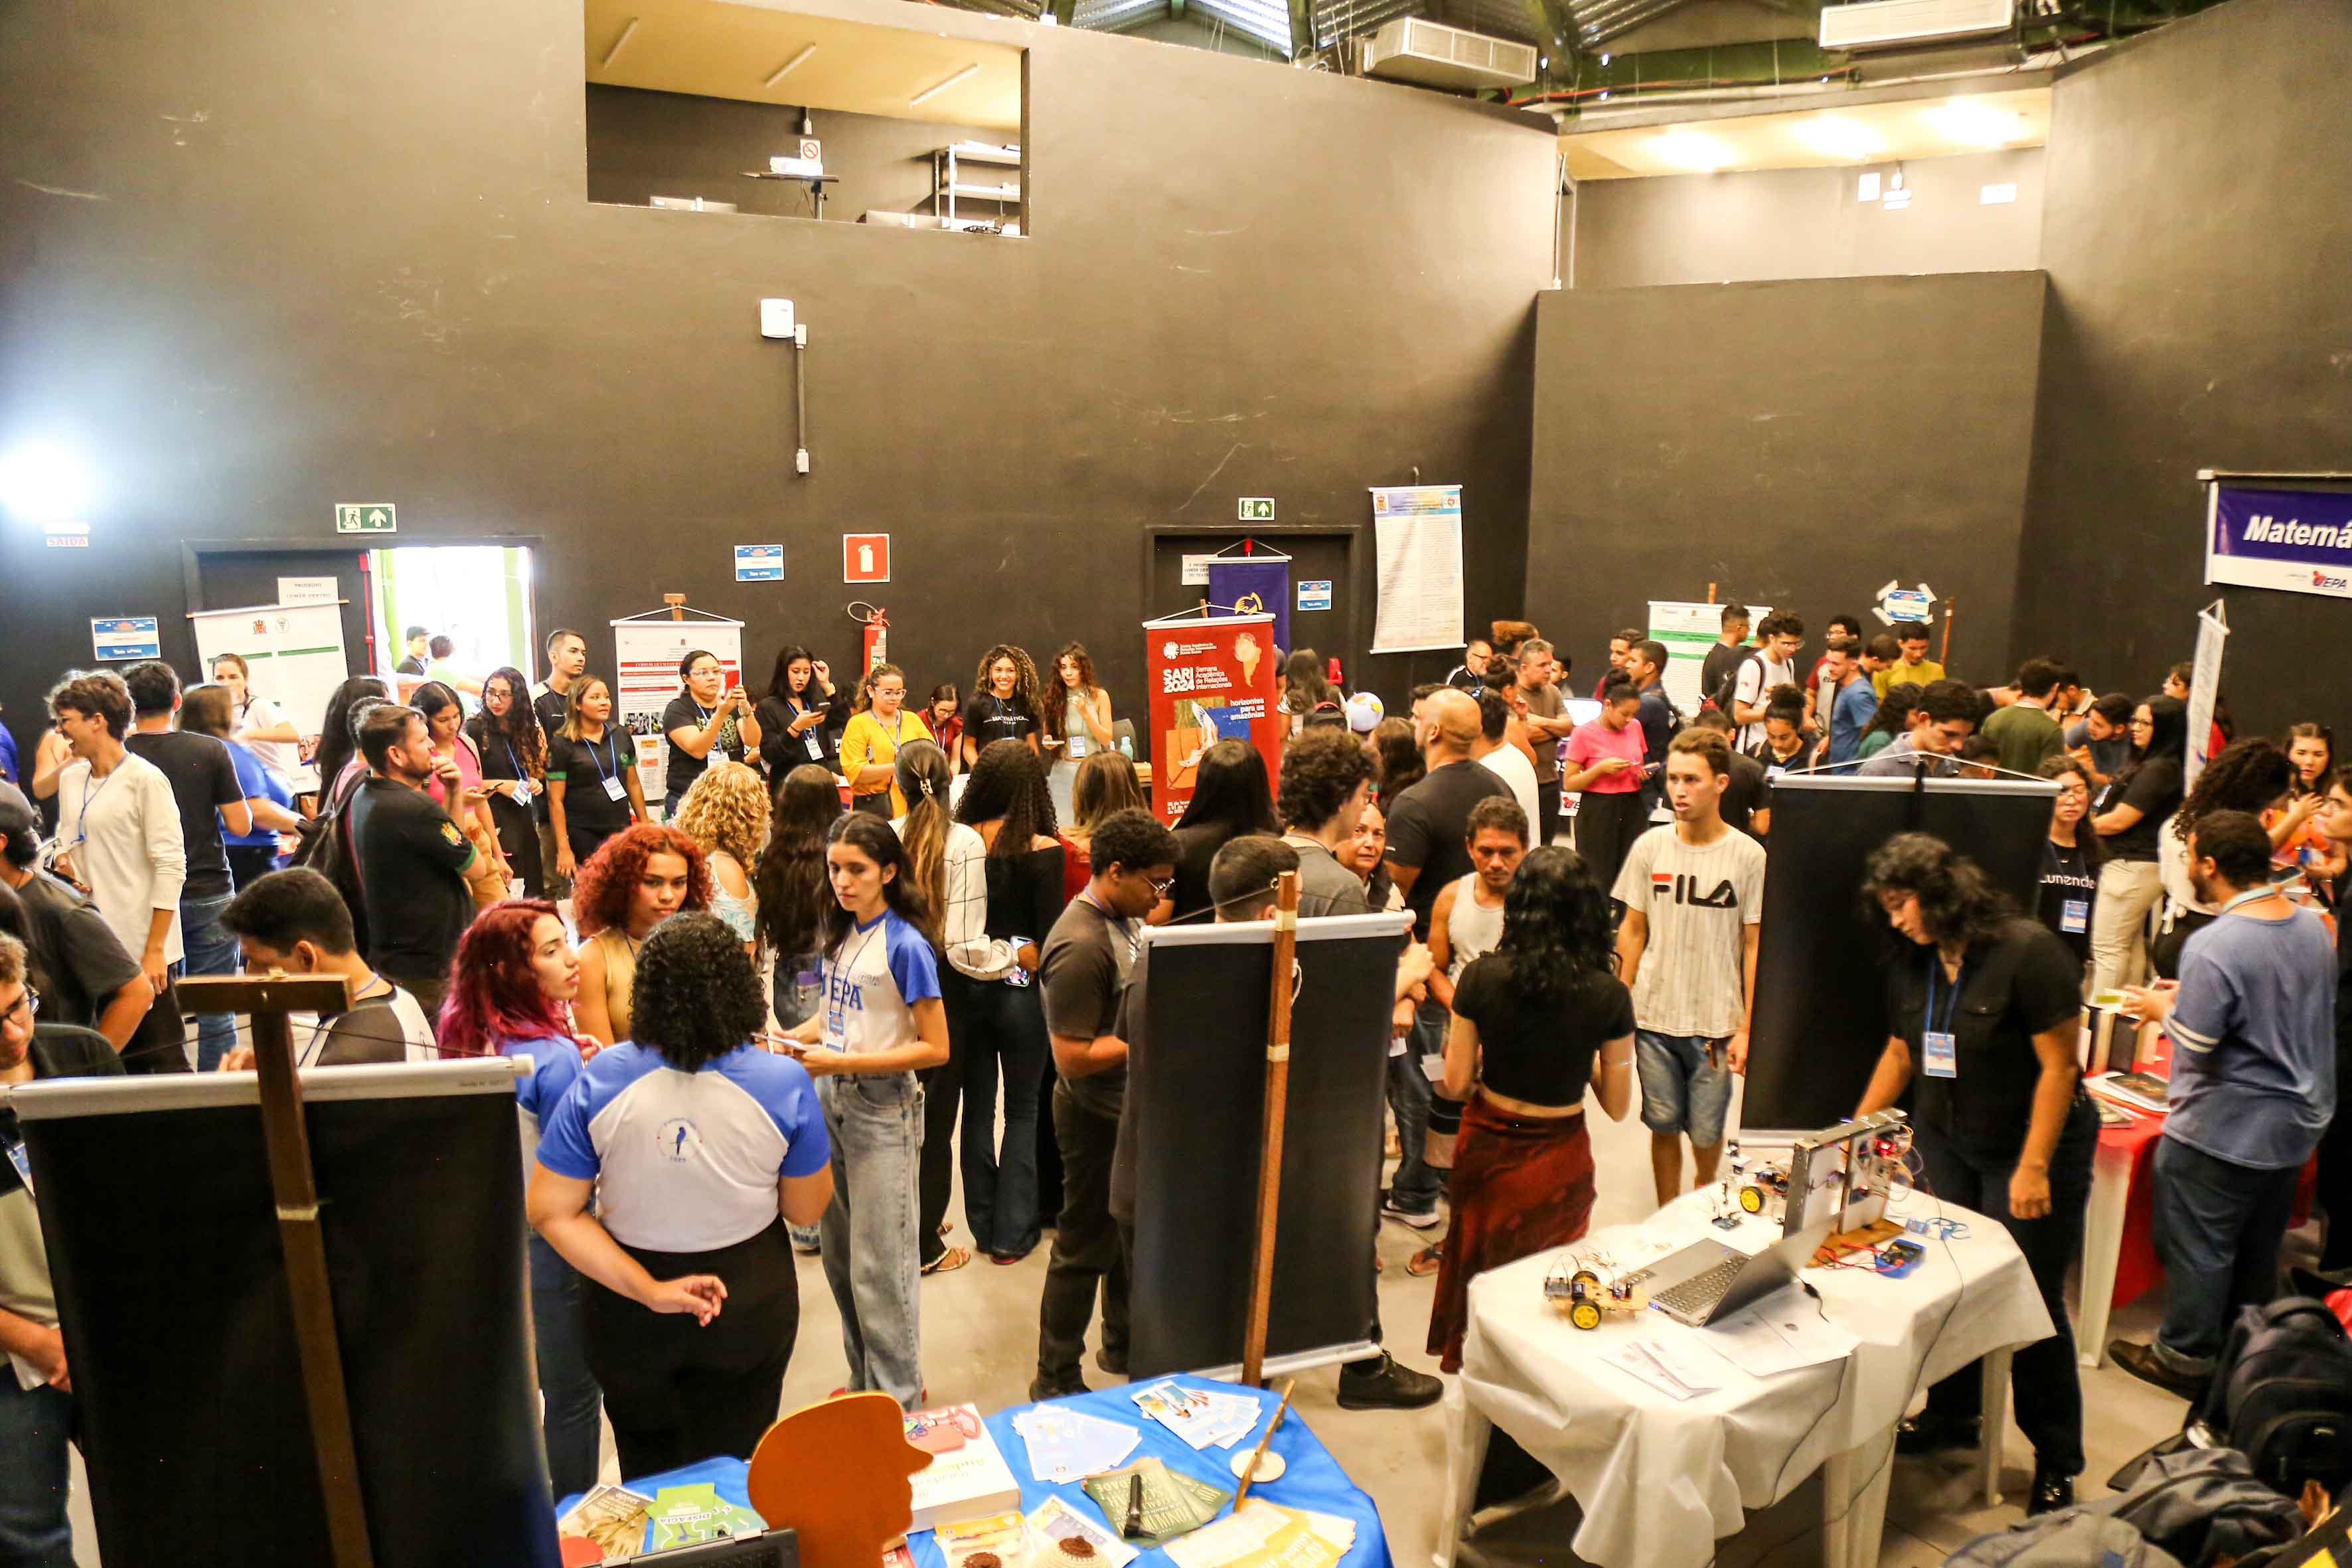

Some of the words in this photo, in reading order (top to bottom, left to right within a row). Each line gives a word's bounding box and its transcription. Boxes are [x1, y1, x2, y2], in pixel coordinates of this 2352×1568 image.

[1163, 667, 1194, 682] SARI
[1163, 678, 1195, 693] 2024
[1230, 698, 1264, 707] horizontes
[1230, 711, 1265, 720] amazônias
[1652, 874, 1738, 909] FILA
